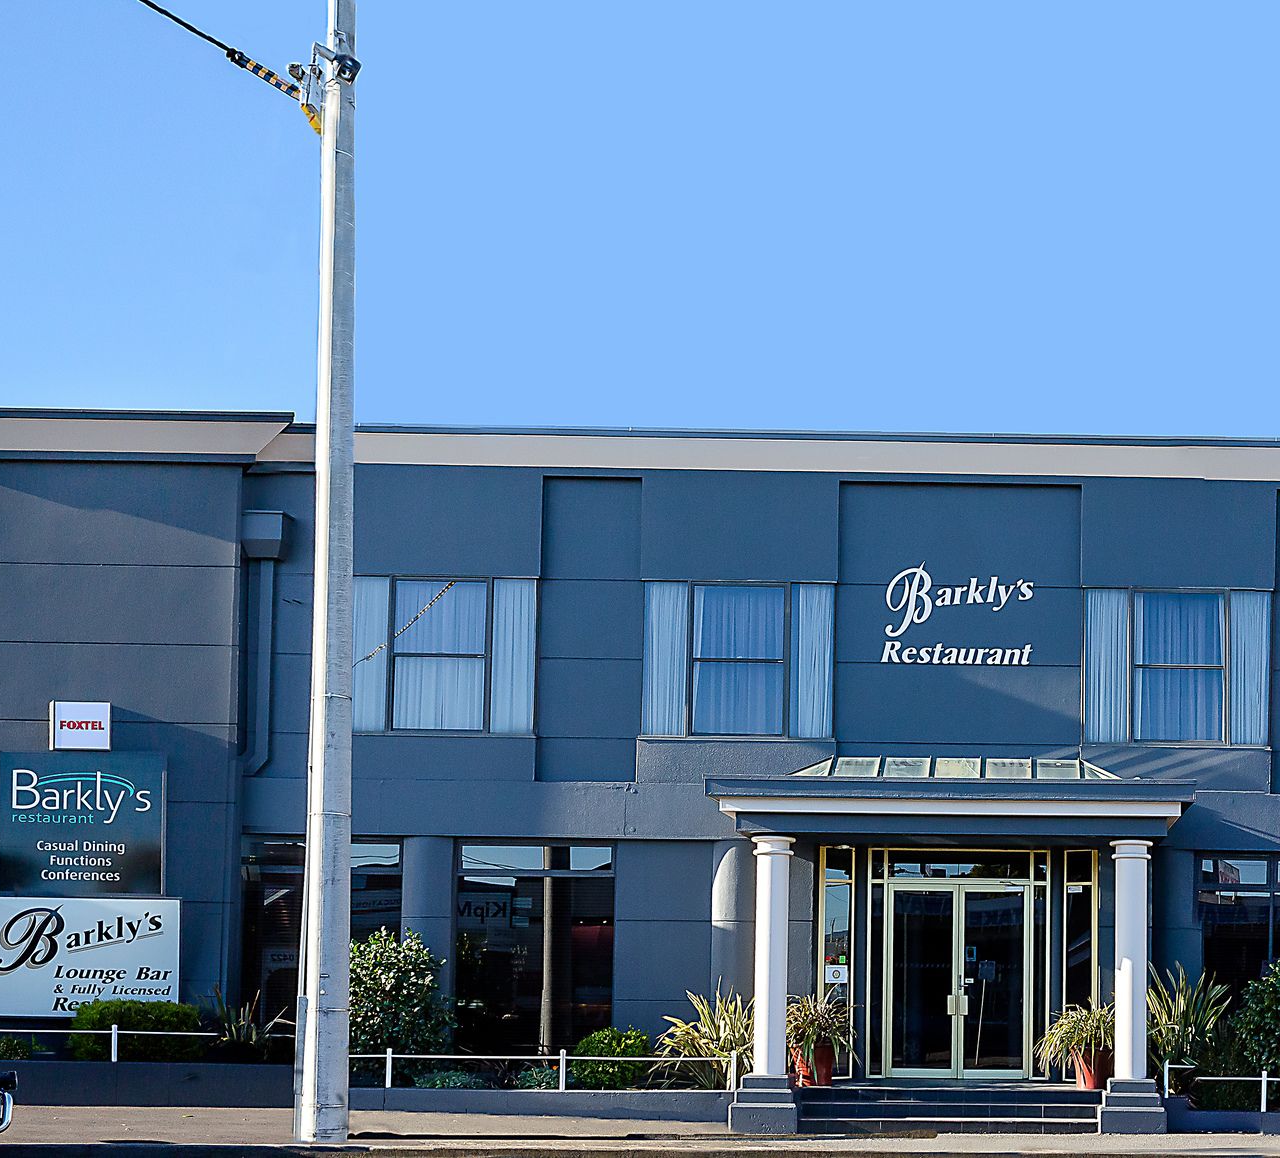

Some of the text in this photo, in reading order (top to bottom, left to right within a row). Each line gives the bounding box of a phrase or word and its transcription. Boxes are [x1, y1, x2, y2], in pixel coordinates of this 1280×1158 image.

[884, 560, 1034, 637] Barkly's
[881, 641, 1033, 665] Restaurant
[59, 720, 105, 731] FOXTEL
[12, 769, 151, 824] Barkly's
[12, 813, 94, 824] restaurant
[36, 840, 126, 855] Casual Dining
[50, 855, 112, 867] Functions
[41, 869, 121, 881] Conferences
[54, 965, 172, 984] Lounge Bar
[53, 984, 172, 997] & Fully Licensed
